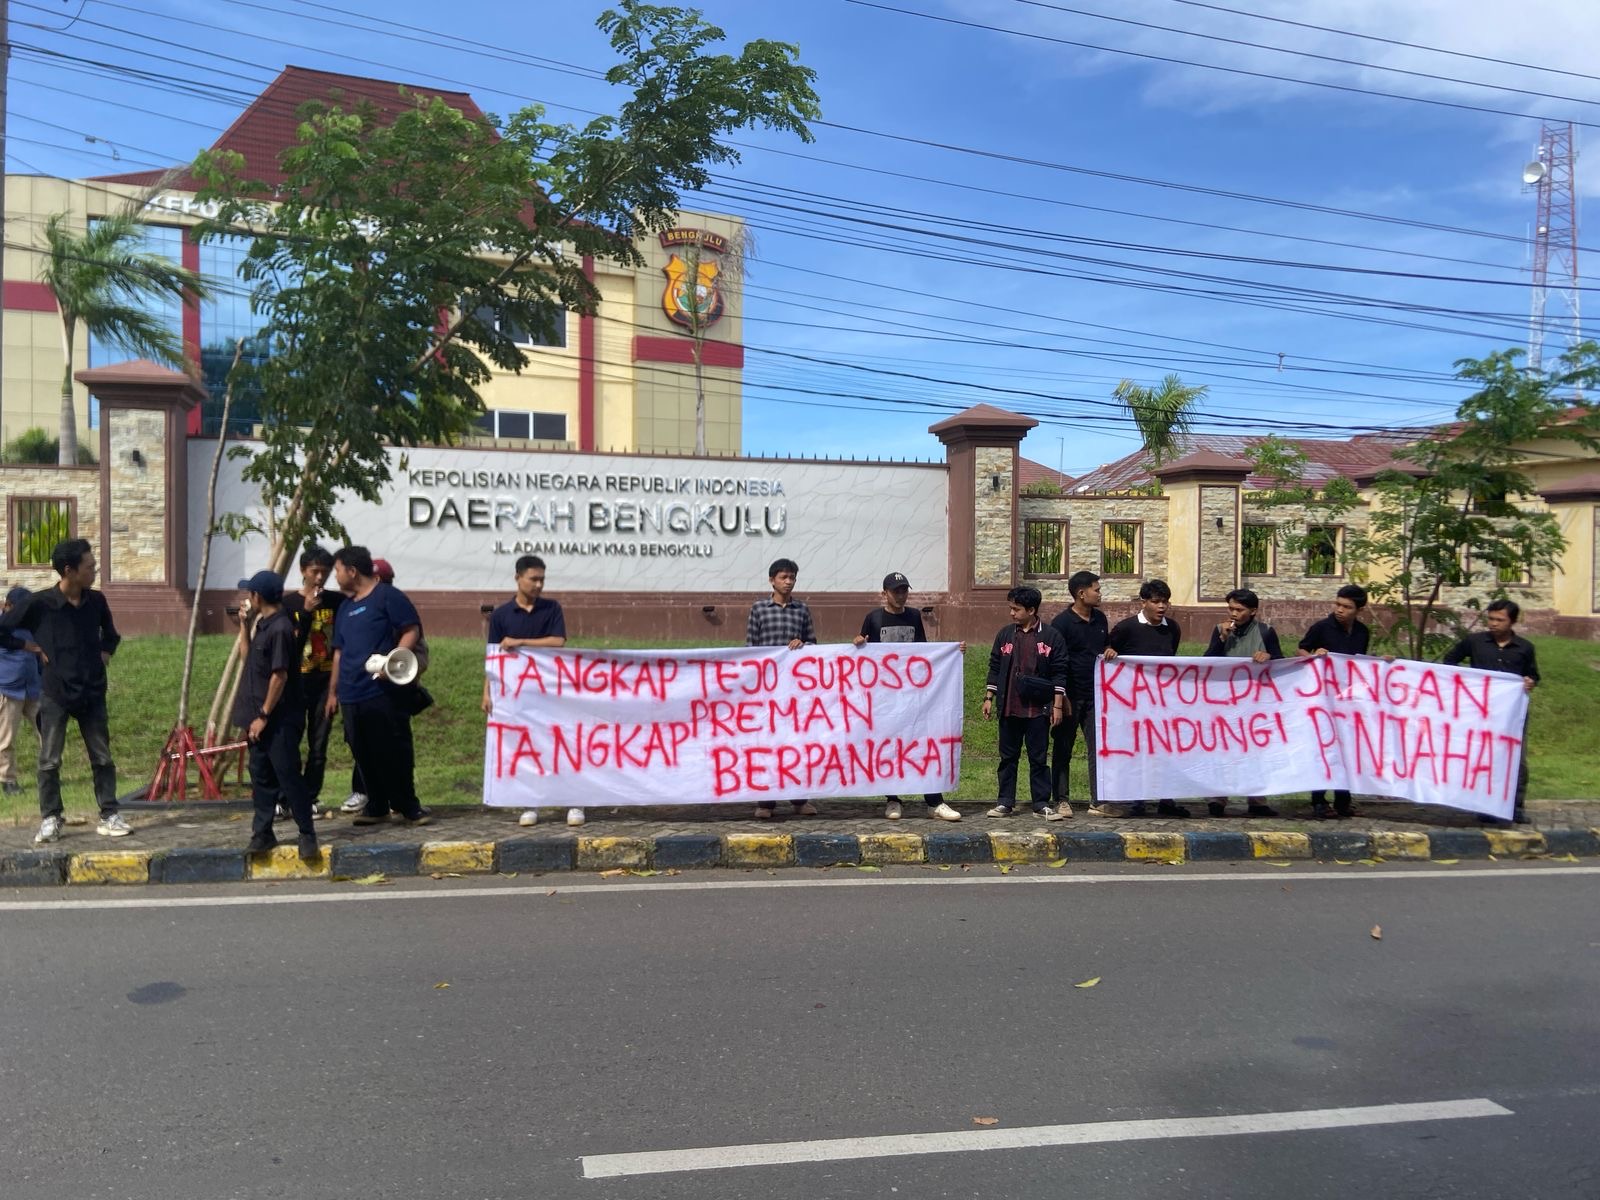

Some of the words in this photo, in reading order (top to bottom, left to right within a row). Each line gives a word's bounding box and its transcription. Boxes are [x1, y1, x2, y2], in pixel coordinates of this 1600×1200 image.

[409, 469, 520, 488] KEPOLISIAN
[526, 473, 601, 490] NEGARA
[605, 475, 690, 493] REPUBLIK
[695, 479, 785, 497] INDONESIA
[408, 496, 576, 531] DAERAH
[588, 501, 787, 537] BENGKULU
[493, 541, 512, 555] JL.
[515, 541, 555, 556] ADAM
[559, 542, 601, 556] MALIK
[640, 544, 714, 558] BENGKULU
[486, 652, 679, 702] TANGKAP
[687, 658, 779, 698] TEJO
[791, 653, 934, 694] SUROSO
[1100, 660, 1284, 713] KAPOLDA
[1294, 656, 1492, 719] JANGAN
[487, 721, 691, 778] TANGKAP
[691, 691, 877, 739] PREMAN
[1098, 711, 1289, 758] LINDUNGI
[712, 735, 963, 797] BERPANGKAT
